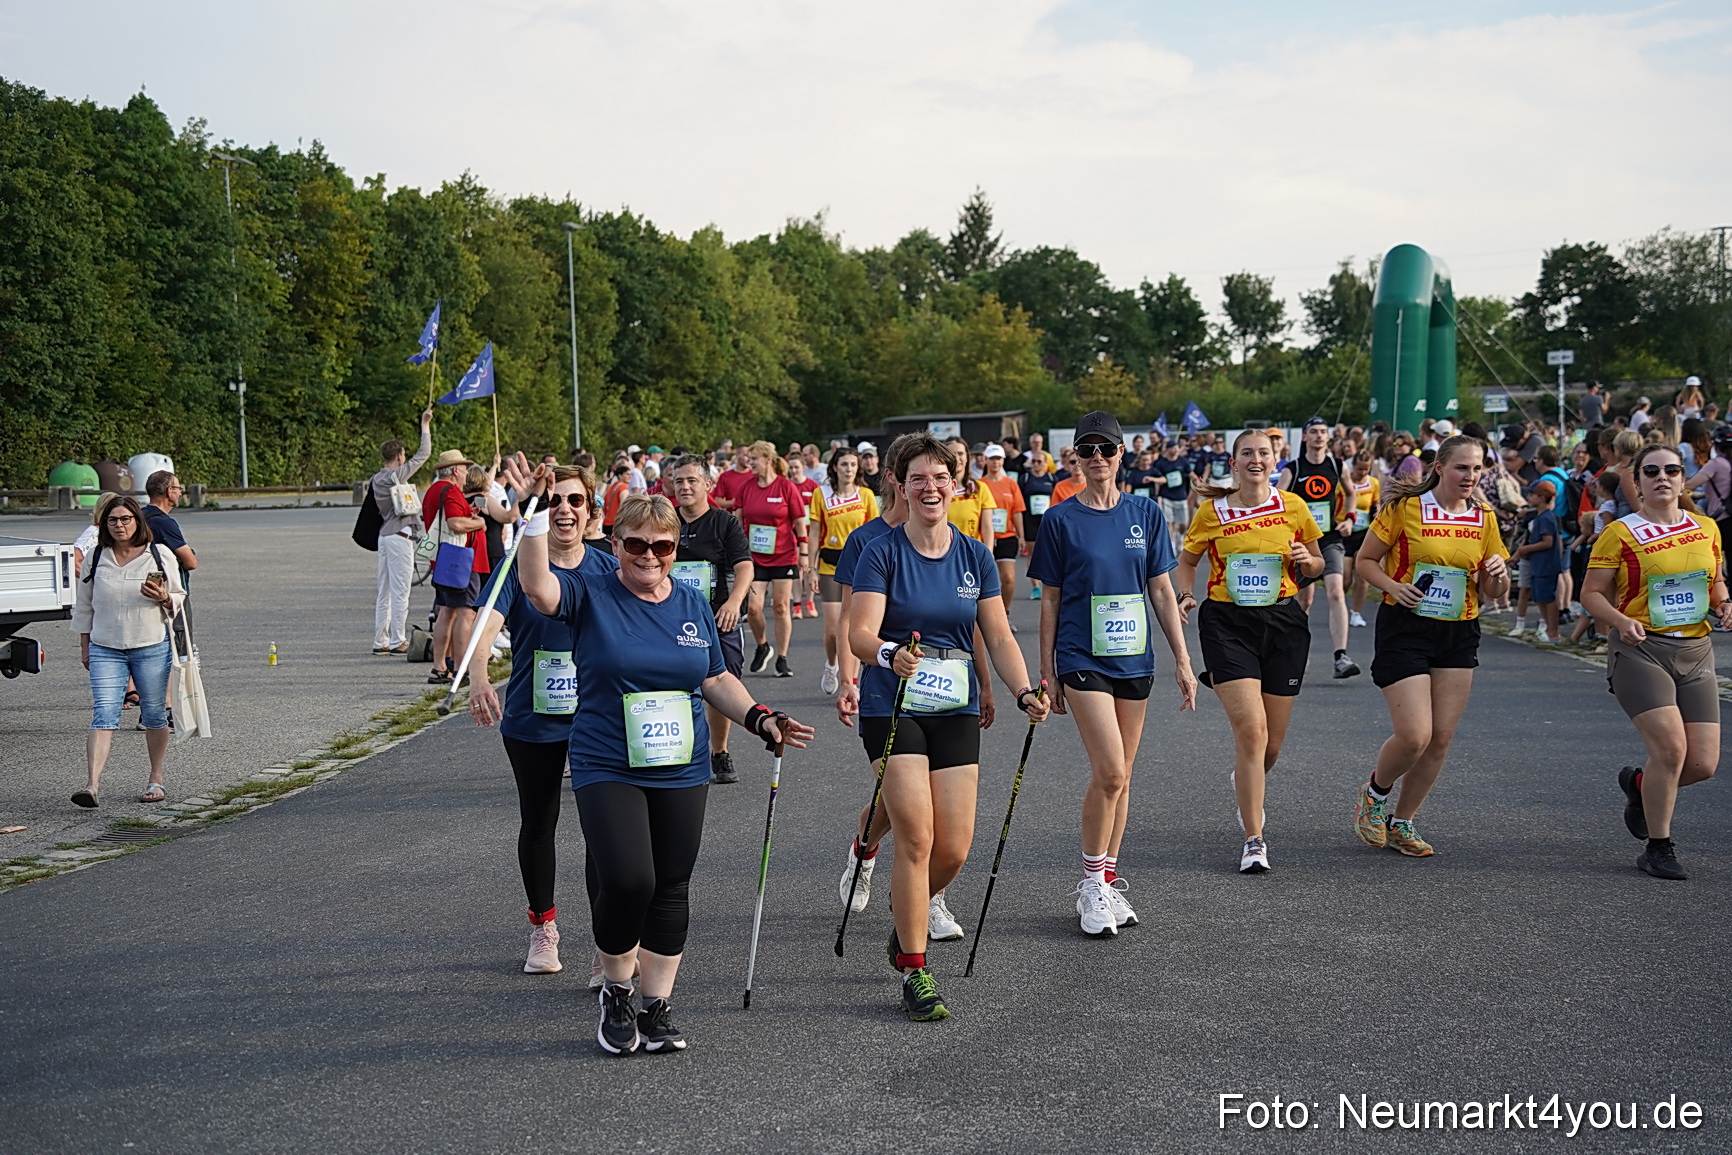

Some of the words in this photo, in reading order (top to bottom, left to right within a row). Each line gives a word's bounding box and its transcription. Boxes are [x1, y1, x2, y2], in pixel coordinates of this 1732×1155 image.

[1222, 523, 1252, 537] MAX
[1255, 517, 1289, 529] BÖGL
[1421, 528, 1451, 538] MAX
[1455, 527, 1482, 540] BÖGL
[1643, 540, 1677, 555] MAX
[1677, 532, 1709, 546] BÖGL
[679, 578, 701, 587] 319
[1237, 575, 1269, 587] 1806
[957, 586, 981, 595] QUART
[1425, 586, 1451, 600] 1714
[1660, 592, 1695, 606] 1588
[1104, 619, 1136, 633] 2210
[677, 634, 708, 645] QUARTZ
[545, 677, 578, 691] 2215
[915, 671, 953, 692] 2212
[906, 685, 934, 698] Susanne
[933, 691, 961, 704] Marthold
[641, 721, 680, 738] 2216
[643, 740, 669, 749] Therese
[669, 739, 683, 748] Riedl
